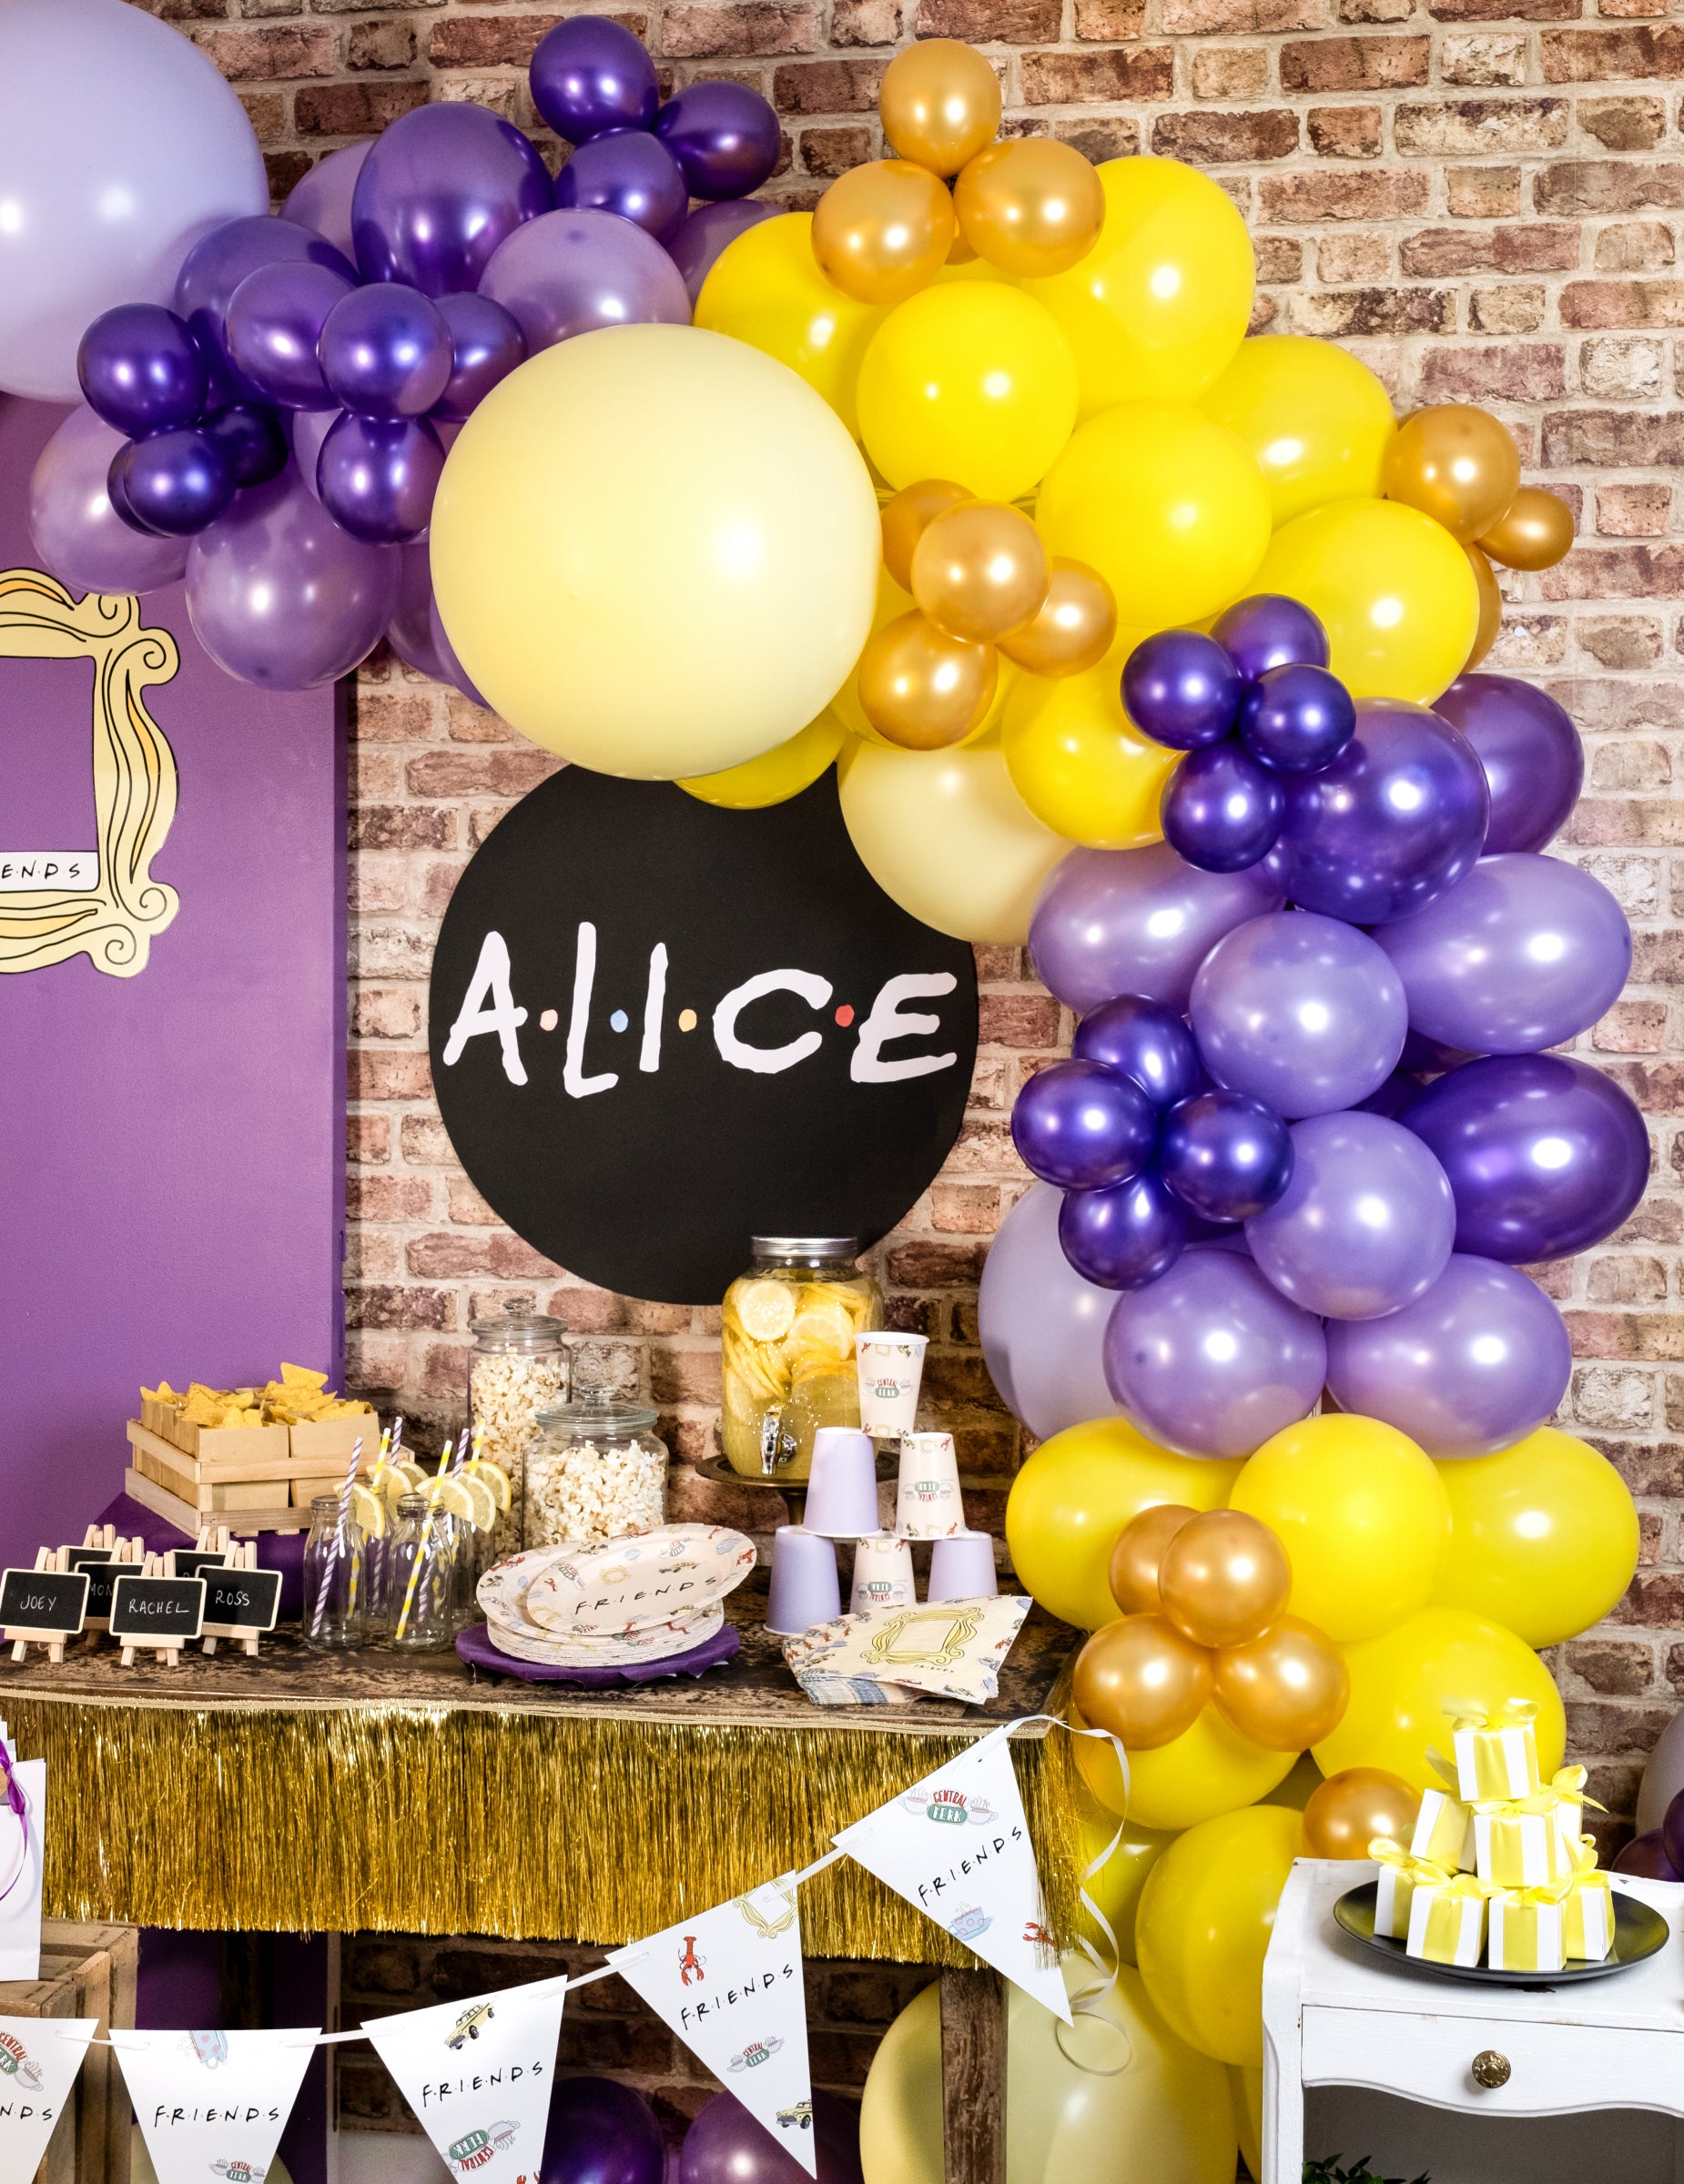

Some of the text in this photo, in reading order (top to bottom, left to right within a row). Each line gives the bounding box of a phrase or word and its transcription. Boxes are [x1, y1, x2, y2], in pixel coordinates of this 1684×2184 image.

[20, 1594, 57, 1612] JOEY
[128, 1598, 190, 1614] RACHEL
[215, 1590, 250, 1607] ROSS
[933, 1789, 967, 1808] CENTRAL
[933, 1805, 962, 1823] PERK
[453, 2133, 484, 2157] PERK
[461, 2145, 494, 2171] CENTRAL
